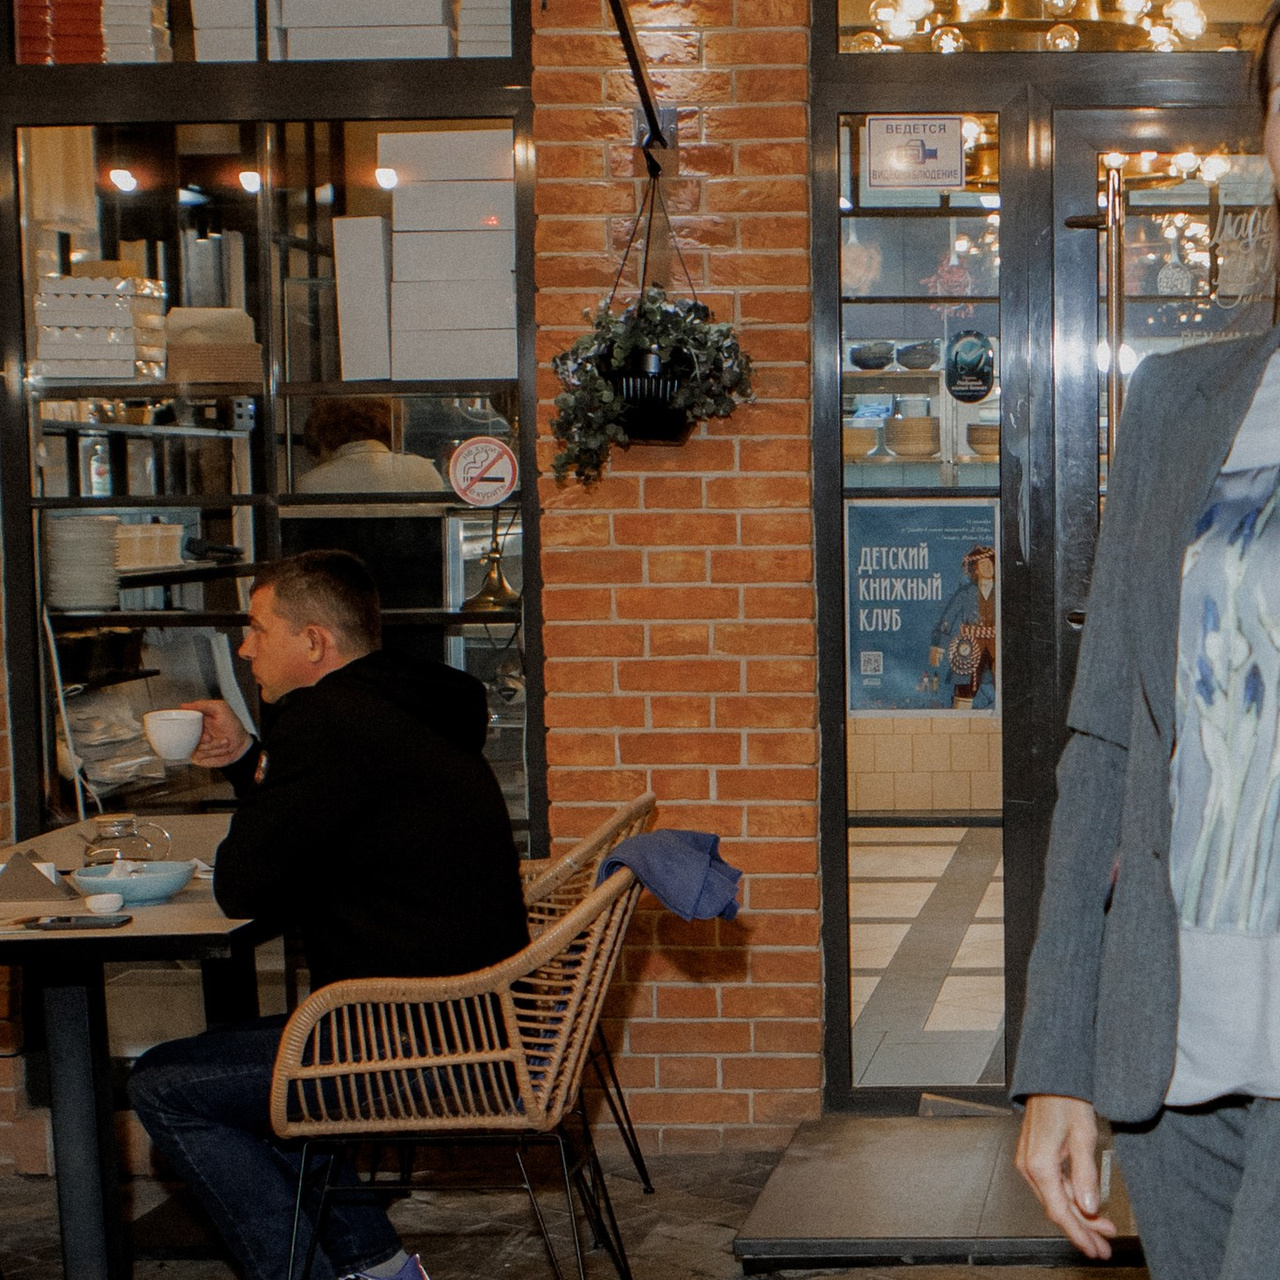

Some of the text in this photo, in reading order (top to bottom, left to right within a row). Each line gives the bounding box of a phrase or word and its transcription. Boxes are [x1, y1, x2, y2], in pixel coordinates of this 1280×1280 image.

[886, 124, 946, 135] ВЕДЕТСЯ
[858, 543, 929, 575] ДЕТСКИЙ
[859, 574, 942, 601] КНИЖНЫЙ
[859, 609, 902, 631] КЛУБ
